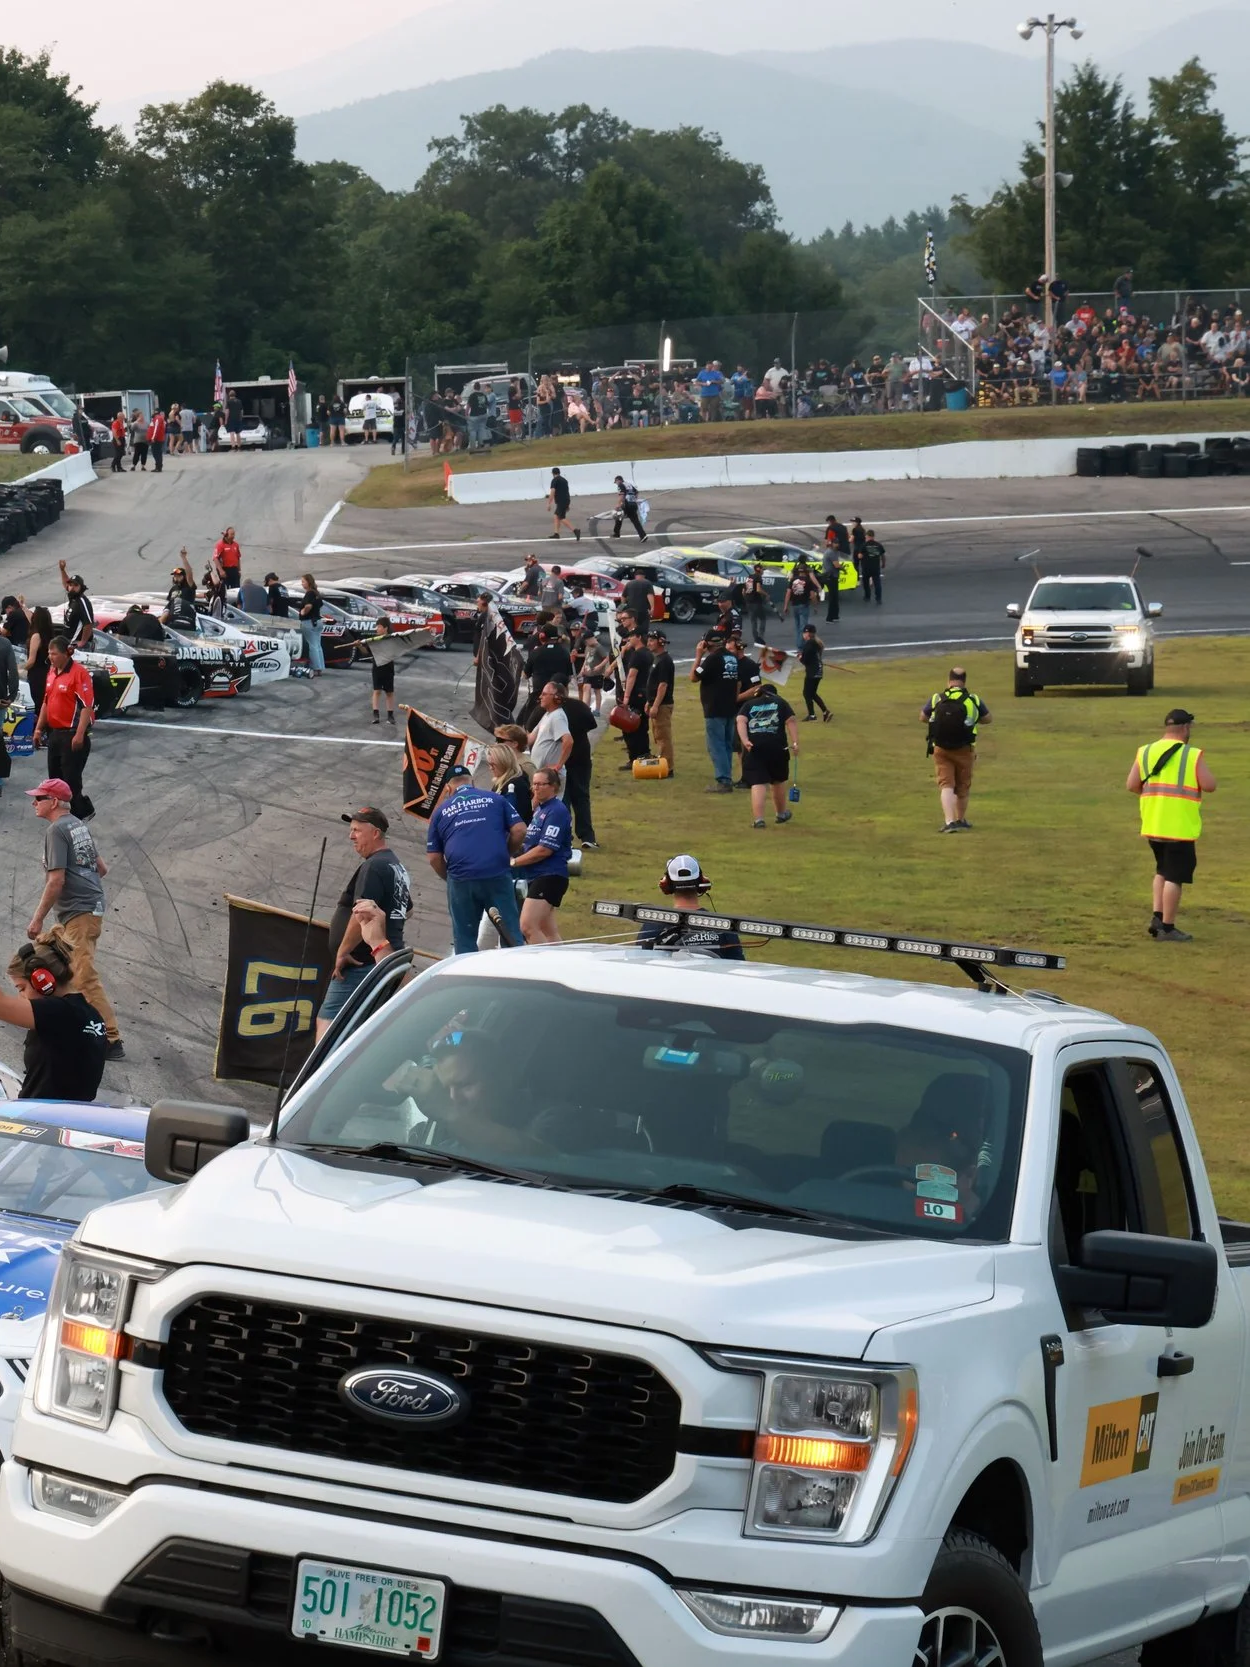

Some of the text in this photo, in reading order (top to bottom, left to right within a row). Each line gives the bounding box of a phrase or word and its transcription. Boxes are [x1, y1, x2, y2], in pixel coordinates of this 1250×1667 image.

[176, 647, 223, 660] JACKSON
[439, 743, 457, 764] Team
[457, 797, 494, 812] HARBOR
[21, 1127, 45, 1137] CAT
[924, 1203, 944, 1216] 10
[370, 1378, 433, 1412] Ford
[1091, 1411, 1156, 1465] Milton CAT
[1178, 1424, 1226, 1471] Join Our Team
[1086, 1498, 1131, 1525] miltoncat.com
[332, 1570, 411, 1590] LIVE FREE OR DIE
[301, 1575, 437, 1634] 501 1052
[301, 1618, 312, 1629] 10
[333, 1626, 399, 1648] HAMPSHIRE
